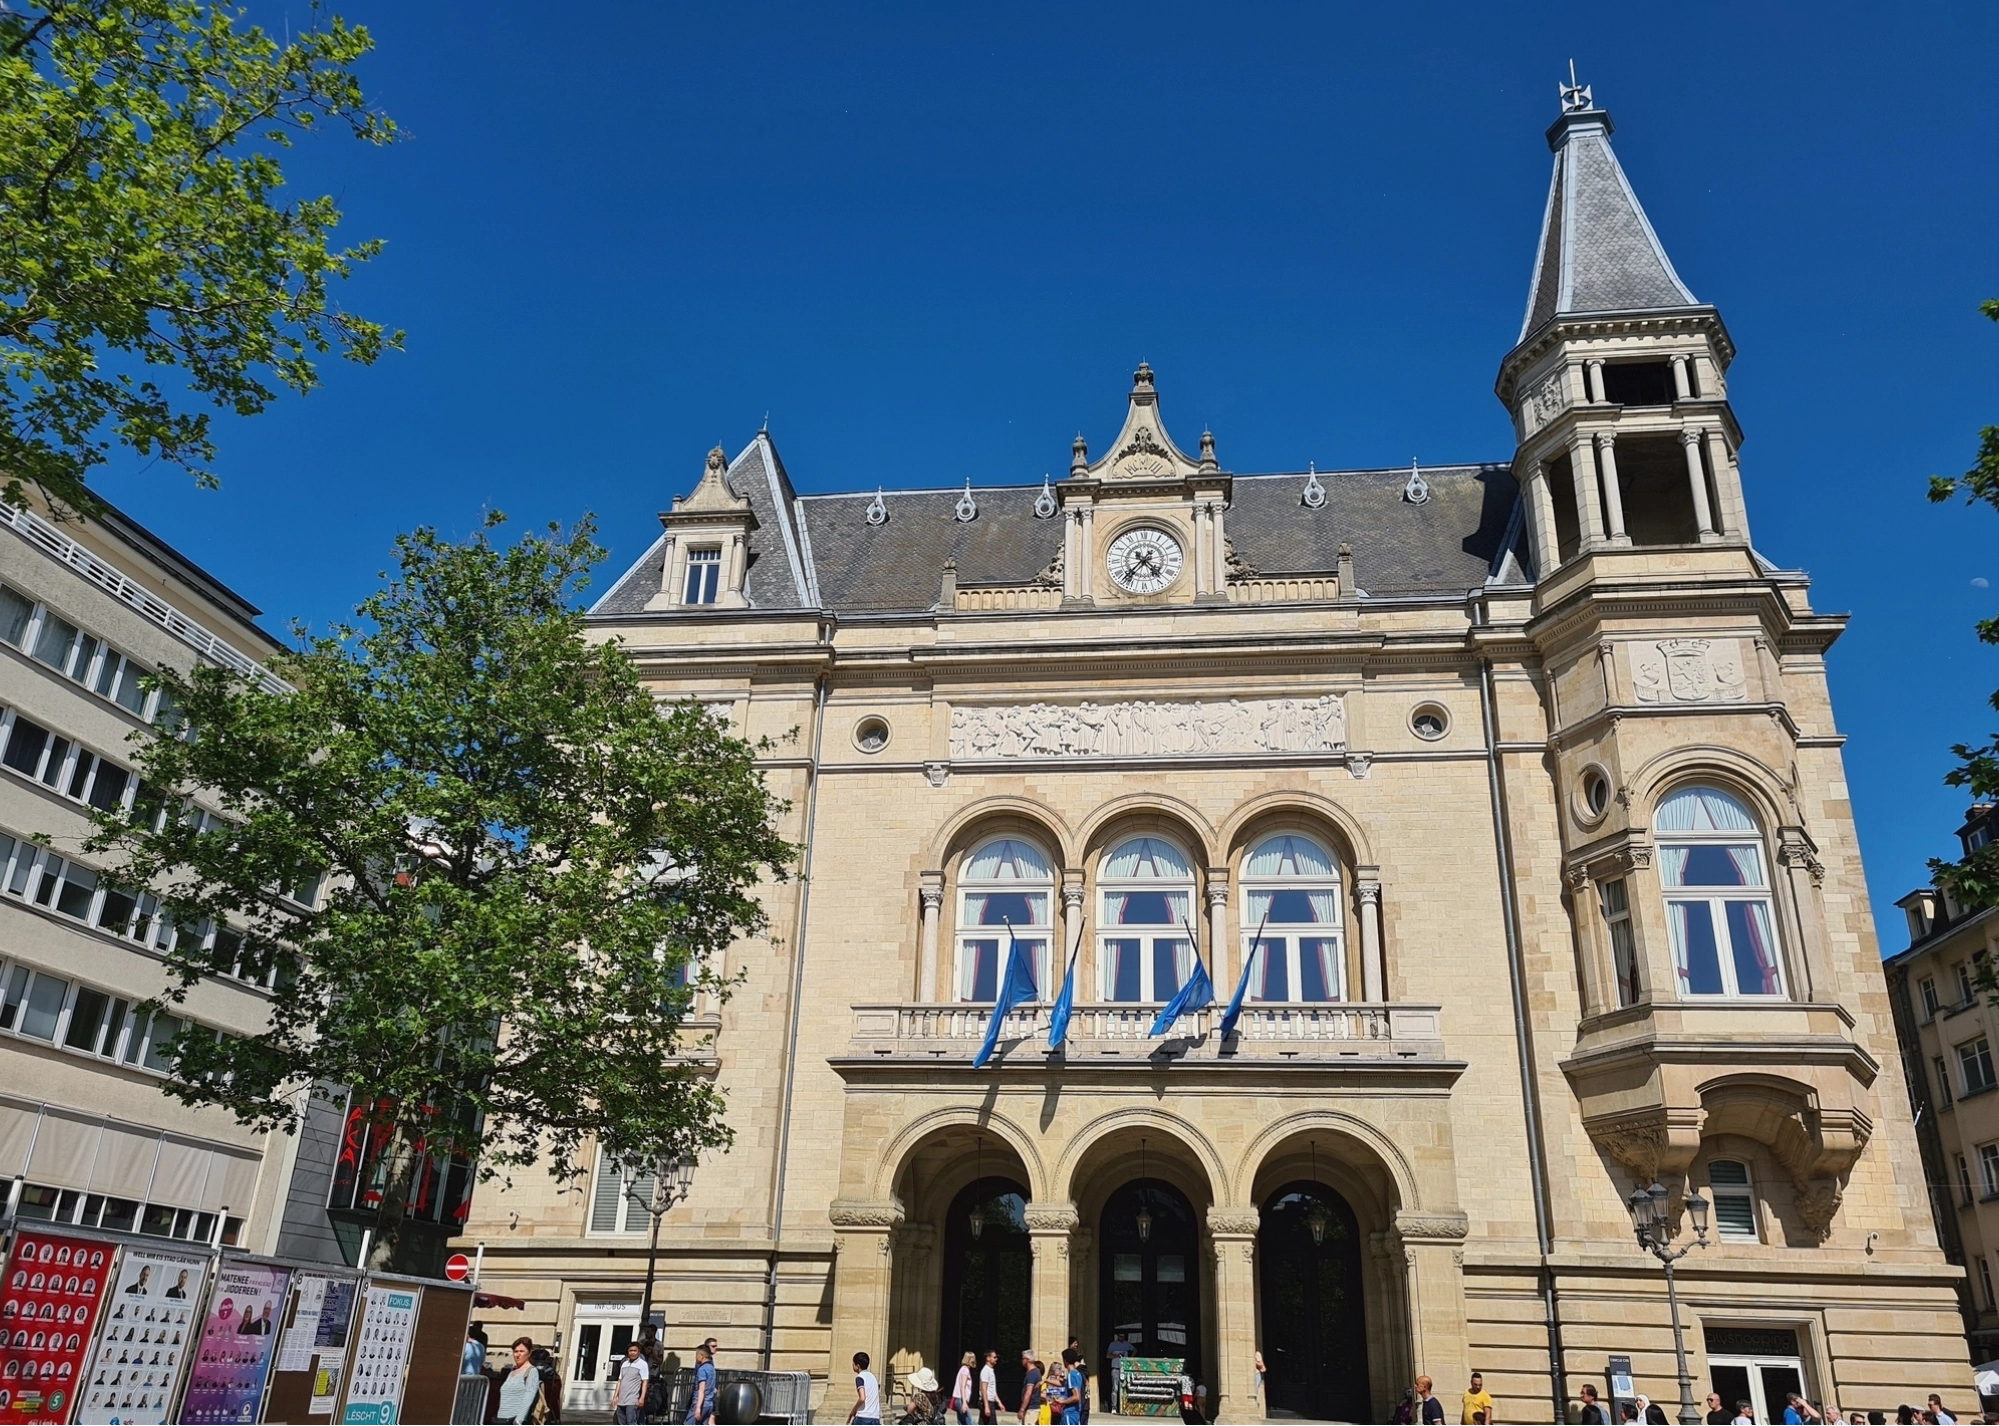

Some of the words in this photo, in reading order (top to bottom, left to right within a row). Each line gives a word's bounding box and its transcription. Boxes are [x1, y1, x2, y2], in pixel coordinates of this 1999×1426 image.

[220, 1273, 250, 1284] MATENEE
[297, 1273, 303, 1285] 8
[363, 1282, 369, 1293] 9
[51, 1394, 61, 1407] 5
[380, 1404, 390, 1424] 9
